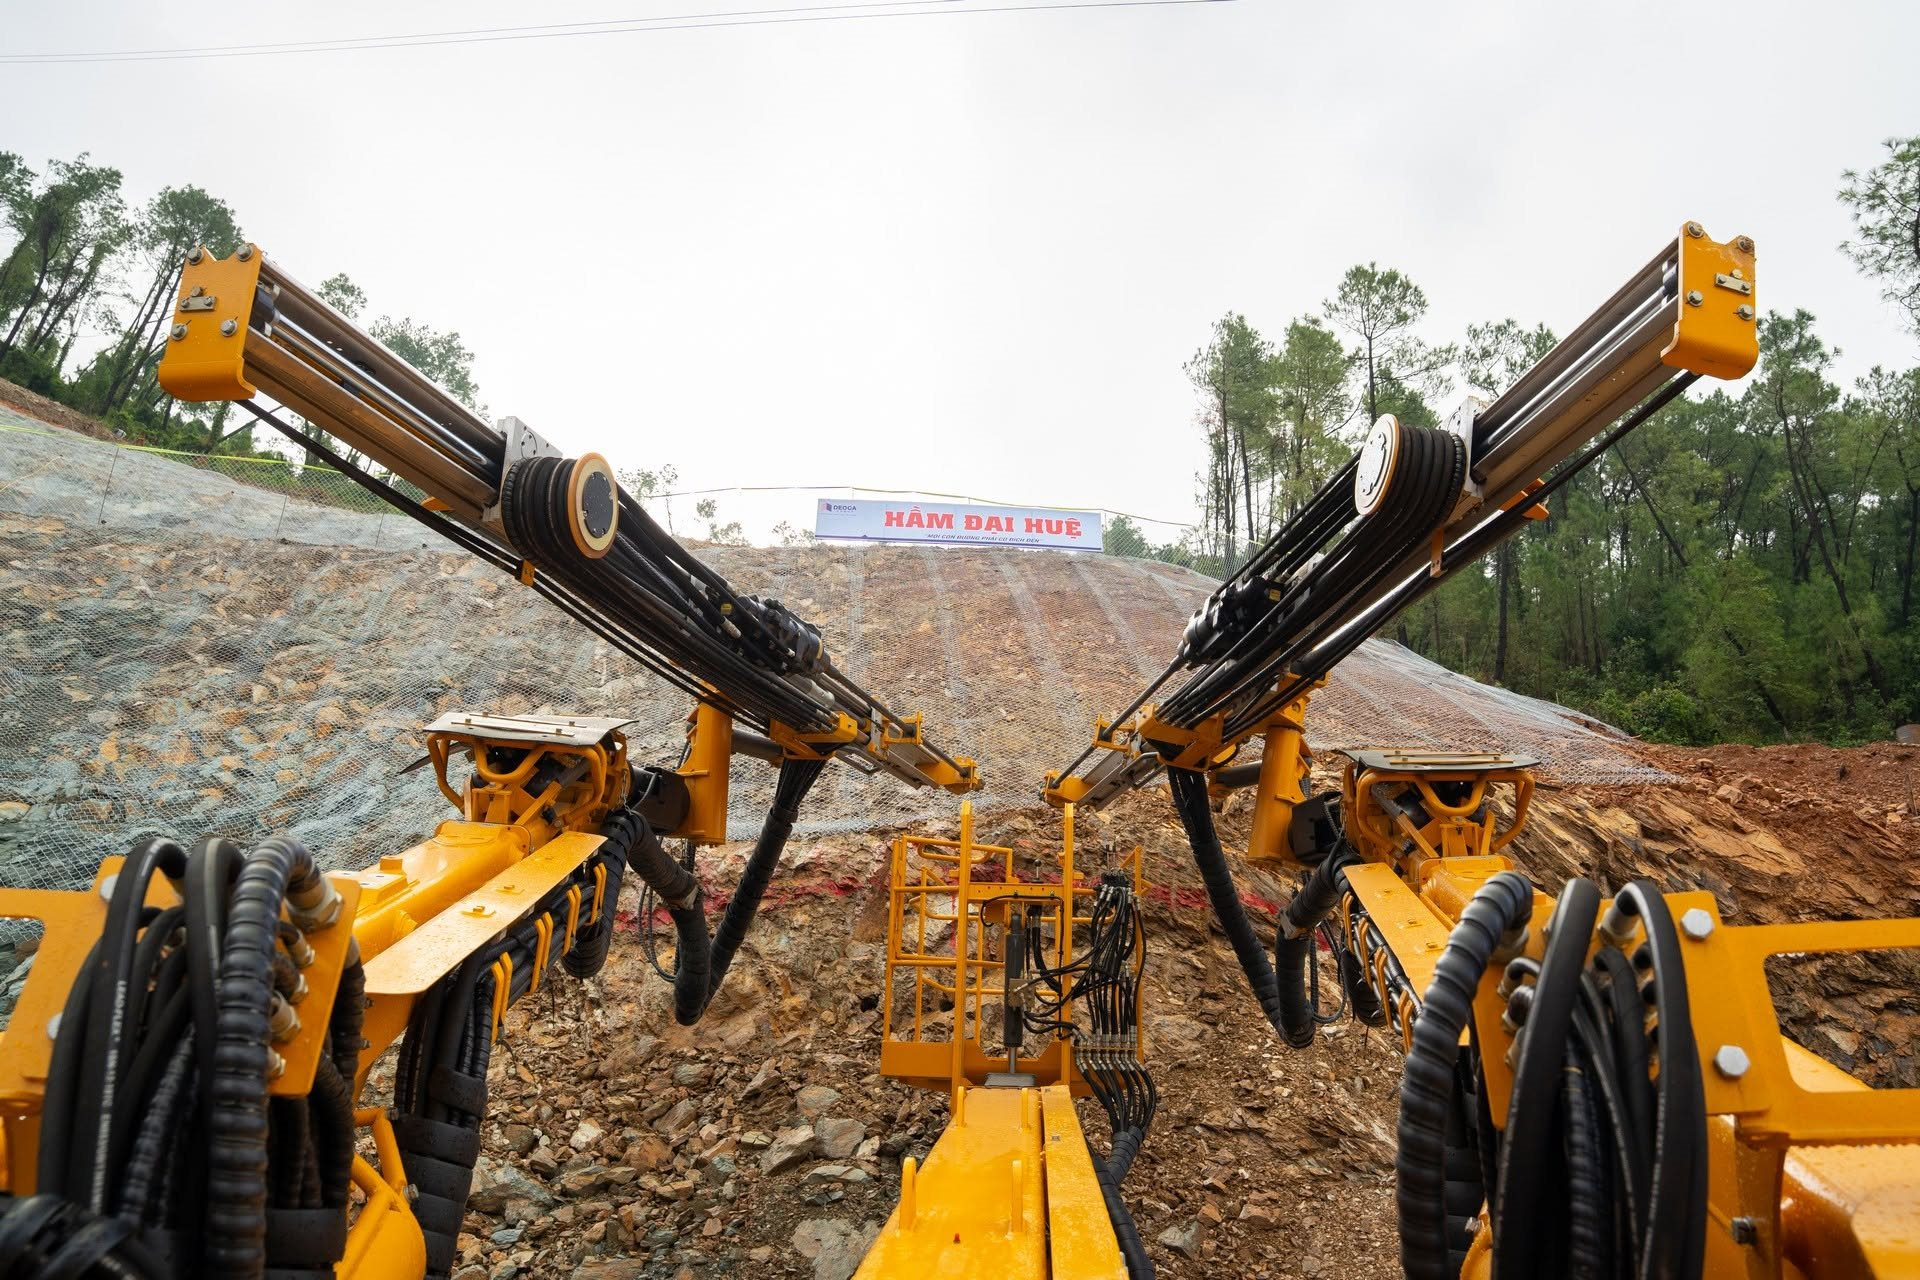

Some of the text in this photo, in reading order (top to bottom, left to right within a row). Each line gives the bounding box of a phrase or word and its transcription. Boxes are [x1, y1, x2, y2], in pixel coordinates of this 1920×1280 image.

[884, 505, 1082, 539] HẦM ĐẠI HUỆ
